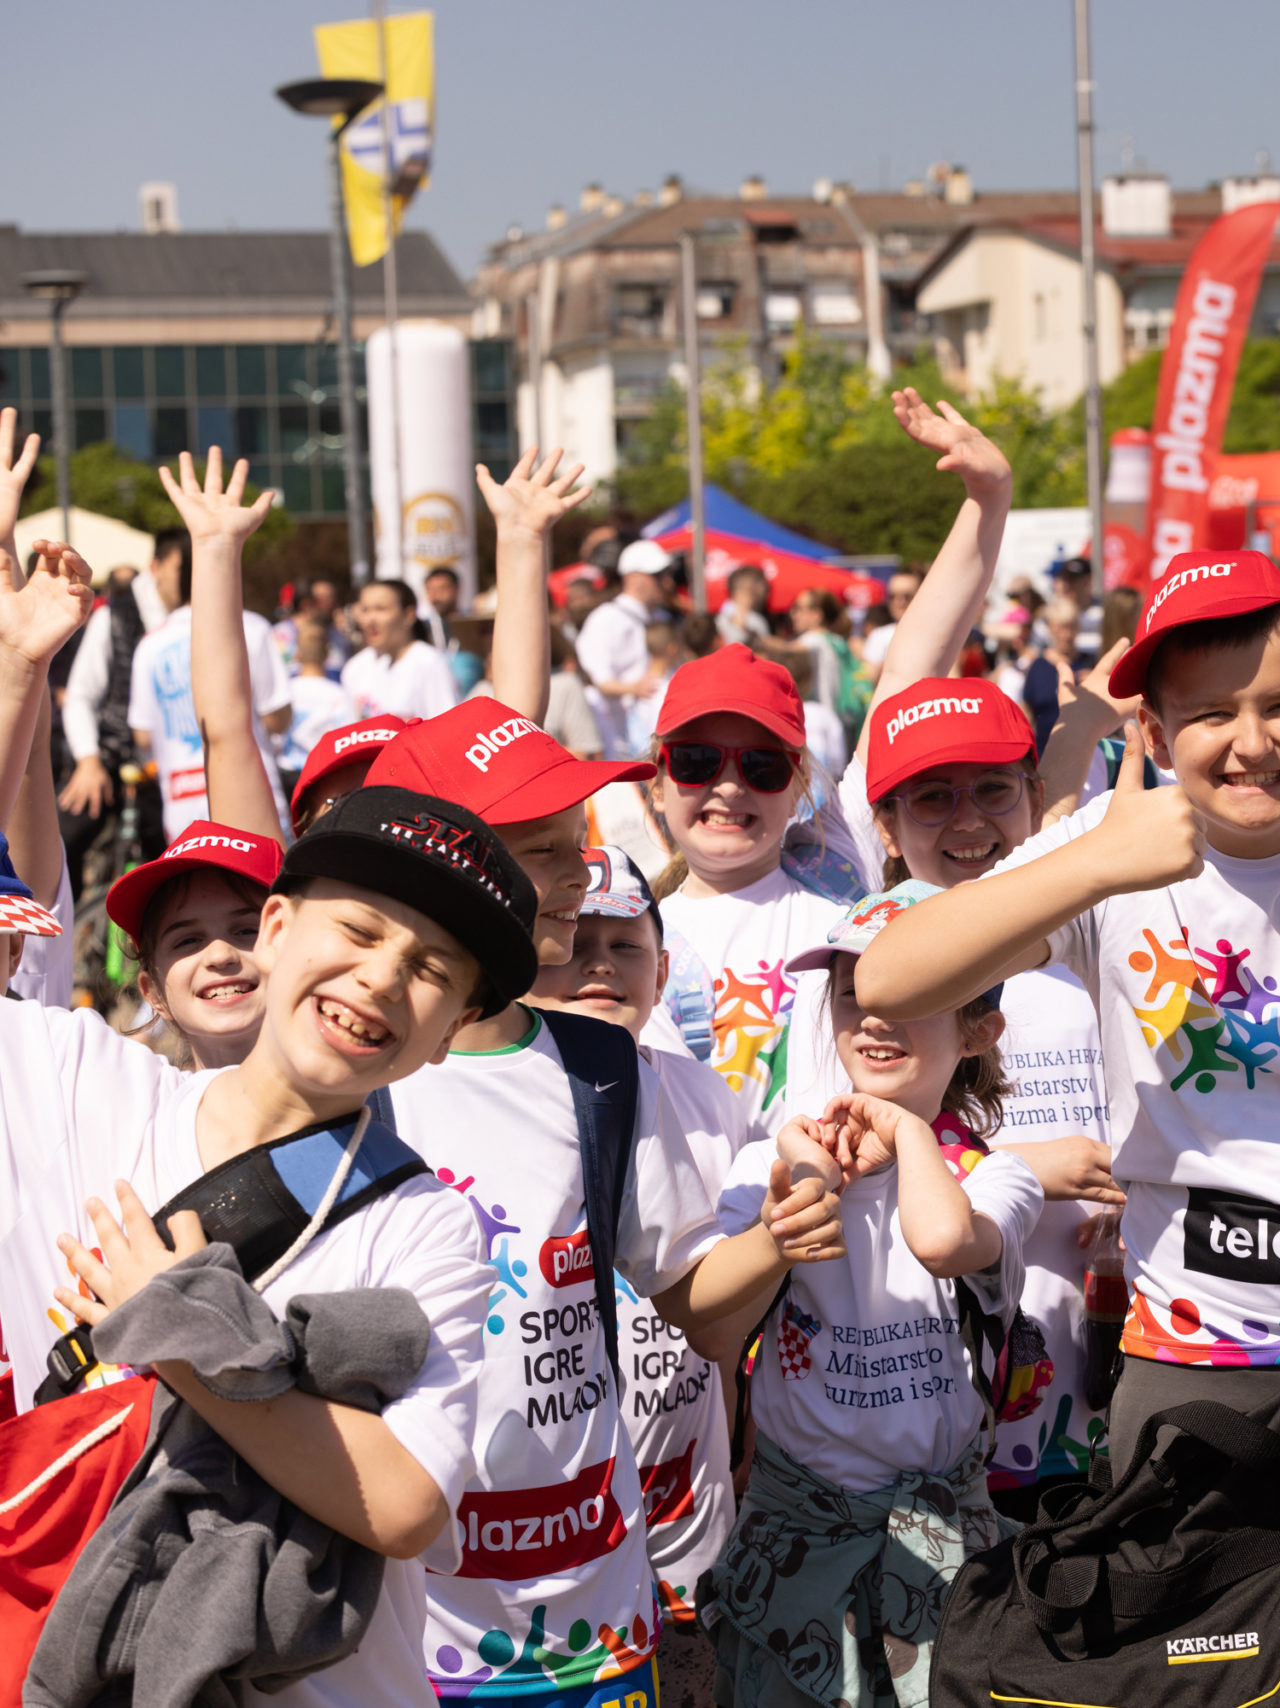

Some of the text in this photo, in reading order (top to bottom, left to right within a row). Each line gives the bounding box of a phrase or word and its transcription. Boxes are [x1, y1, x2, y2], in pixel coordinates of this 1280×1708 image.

[1154, 278, 1236, 493] plazma
[1146, 562, 1238, 634] plazma
[886, 697, 983, 745] plazma
[380, 823, 511, 908] THE LAST JEDI
[1061, 1101, 1070, 1122] i
[524, 1343, 586, 1386] IGRE
[910, 1377, 919, 1400] i
[457, 1494, 604, 1552] lazma
[1166, 1632, 1260, 1655] KÄRCHER
